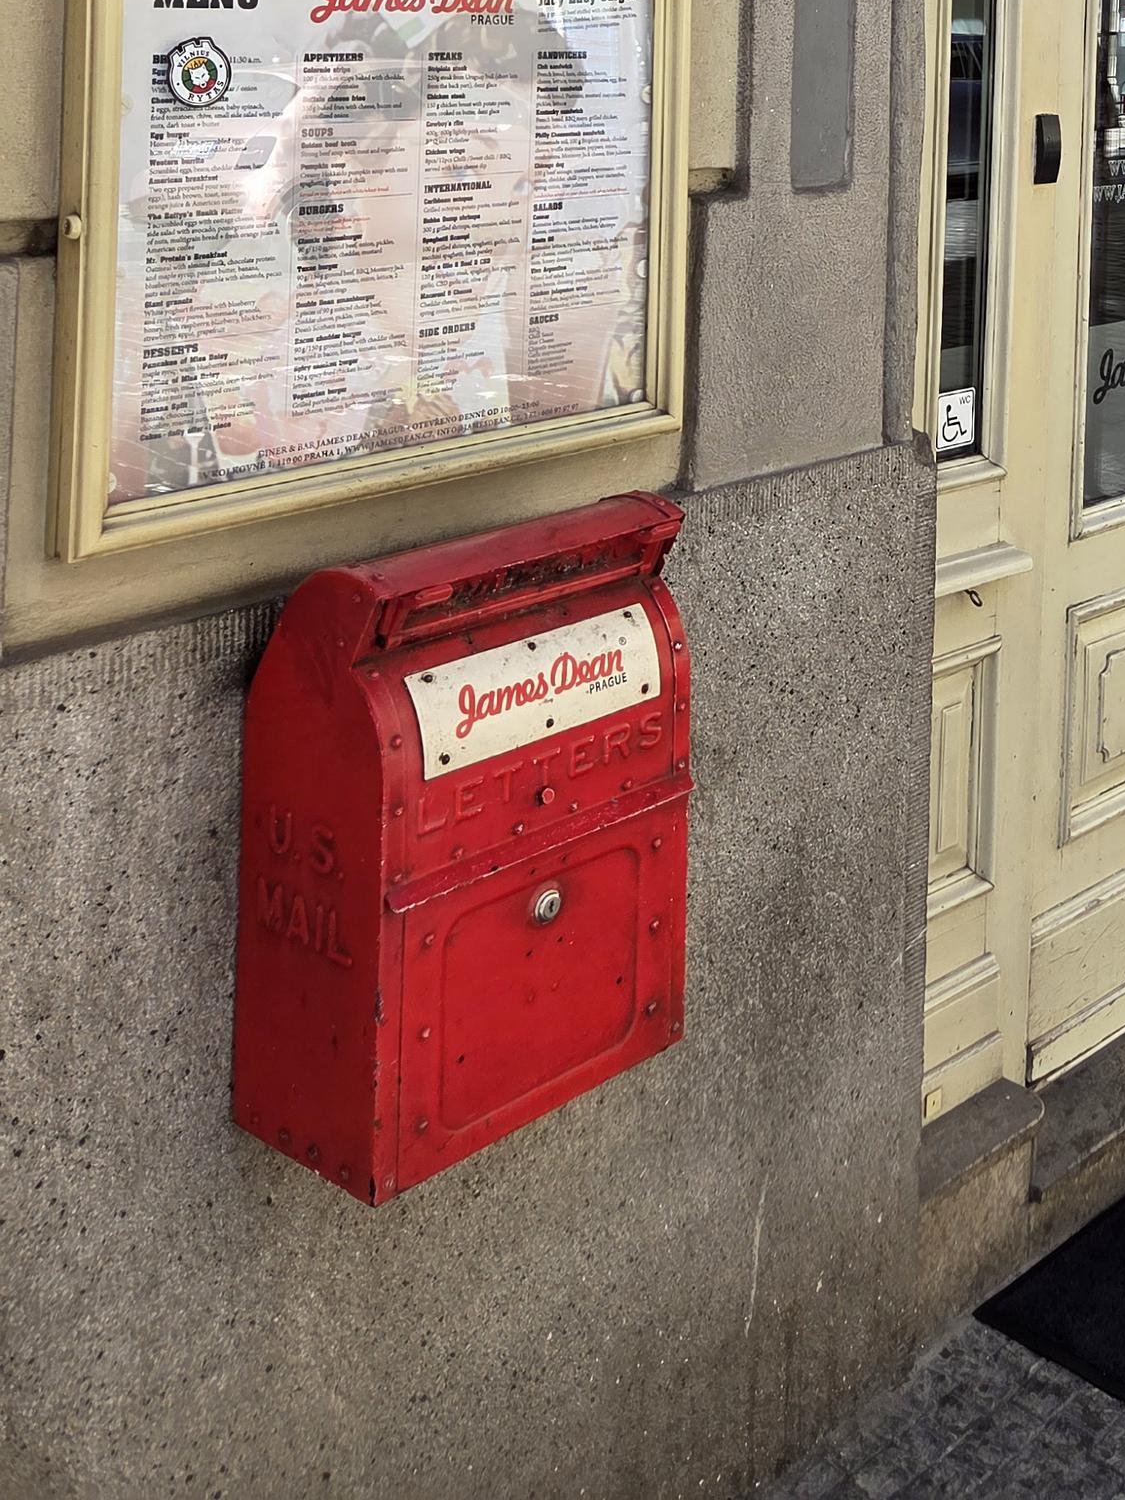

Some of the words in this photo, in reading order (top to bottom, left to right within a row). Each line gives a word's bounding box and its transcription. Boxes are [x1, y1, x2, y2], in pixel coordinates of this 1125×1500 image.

[471, 15, 514, 25] PRAGUE
[177, 50, 210, 68] VILNIUS
[304, 53, 363, 62] APPETIZERS
[428, 52, 462, 61] STEAKS
[538, 51, 587, 60] SANDWICHES
[188, 81, 224, 101] RYTAS
[301, 128, 333, 138] SOUPS
[424, 181, 491, 193] INTERNATIONAL
[299, 204, 344, 216] BURGERS
[533, 202, 563, 212] SALADS
[194, 251, 227, 260] Breakfast
[529, 313, 559, 325] SAUCES
[419, 328, 439, 338] SIDE
[443, 322, 475, 334] ORDERS
[143, 344, 198, 359] DESSERTS
[959, 395, 970, 404] WC
[412, 416, 457, 430] OTEVŘENO
[487, 407, 499, 416] OD
[314, 435, 344, 449] JAMES
[346, 431, 370, 443] DEAN
[304, 450, 334, 463] PRAHA
[589, 673, 628, 695] PRAGUE
[456, 672, 549, 739] James
[551, 649, 624, 695] Dean
[417, 711, 663, 837] LETTERS
[257, 876, 352, 967] MAIL
